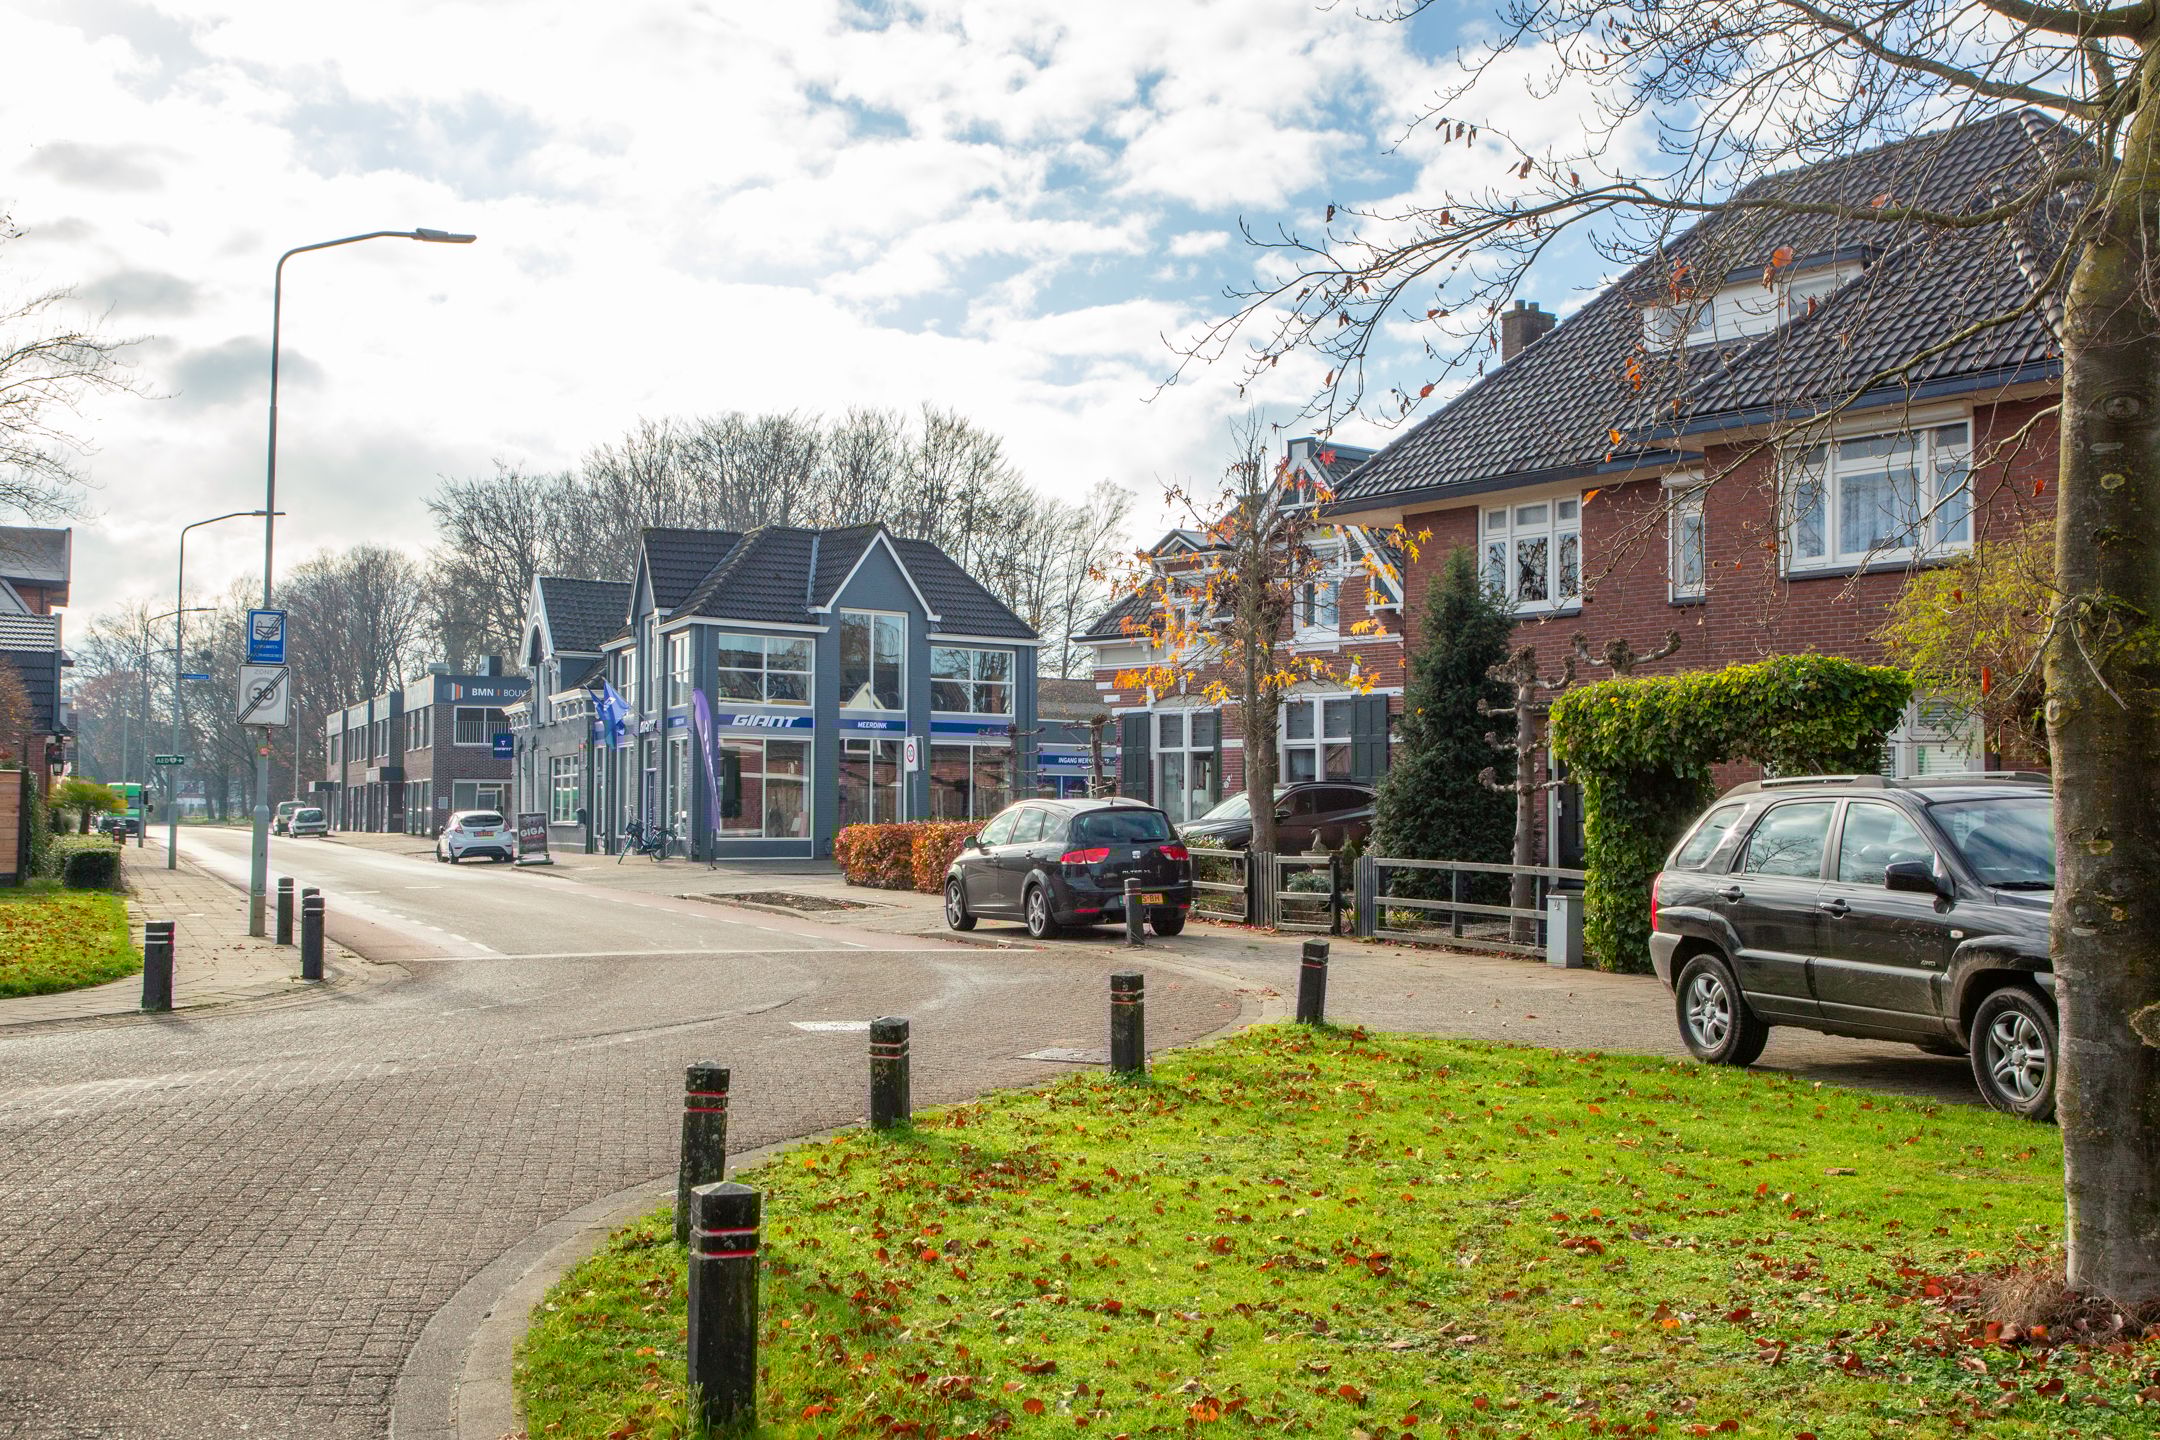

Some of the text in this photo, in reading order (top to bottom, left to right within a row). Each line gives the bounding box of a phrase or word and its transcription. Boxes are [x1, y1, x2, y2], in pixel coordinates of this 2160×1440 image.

[252, 687, 274, 701] 30
[472, 687, 494, 697] BMN
[731, 714, 801, 728] GIANT
[857, 721, 888, 729] MEERDINK
[520, 826, 545, 837] GIGA
